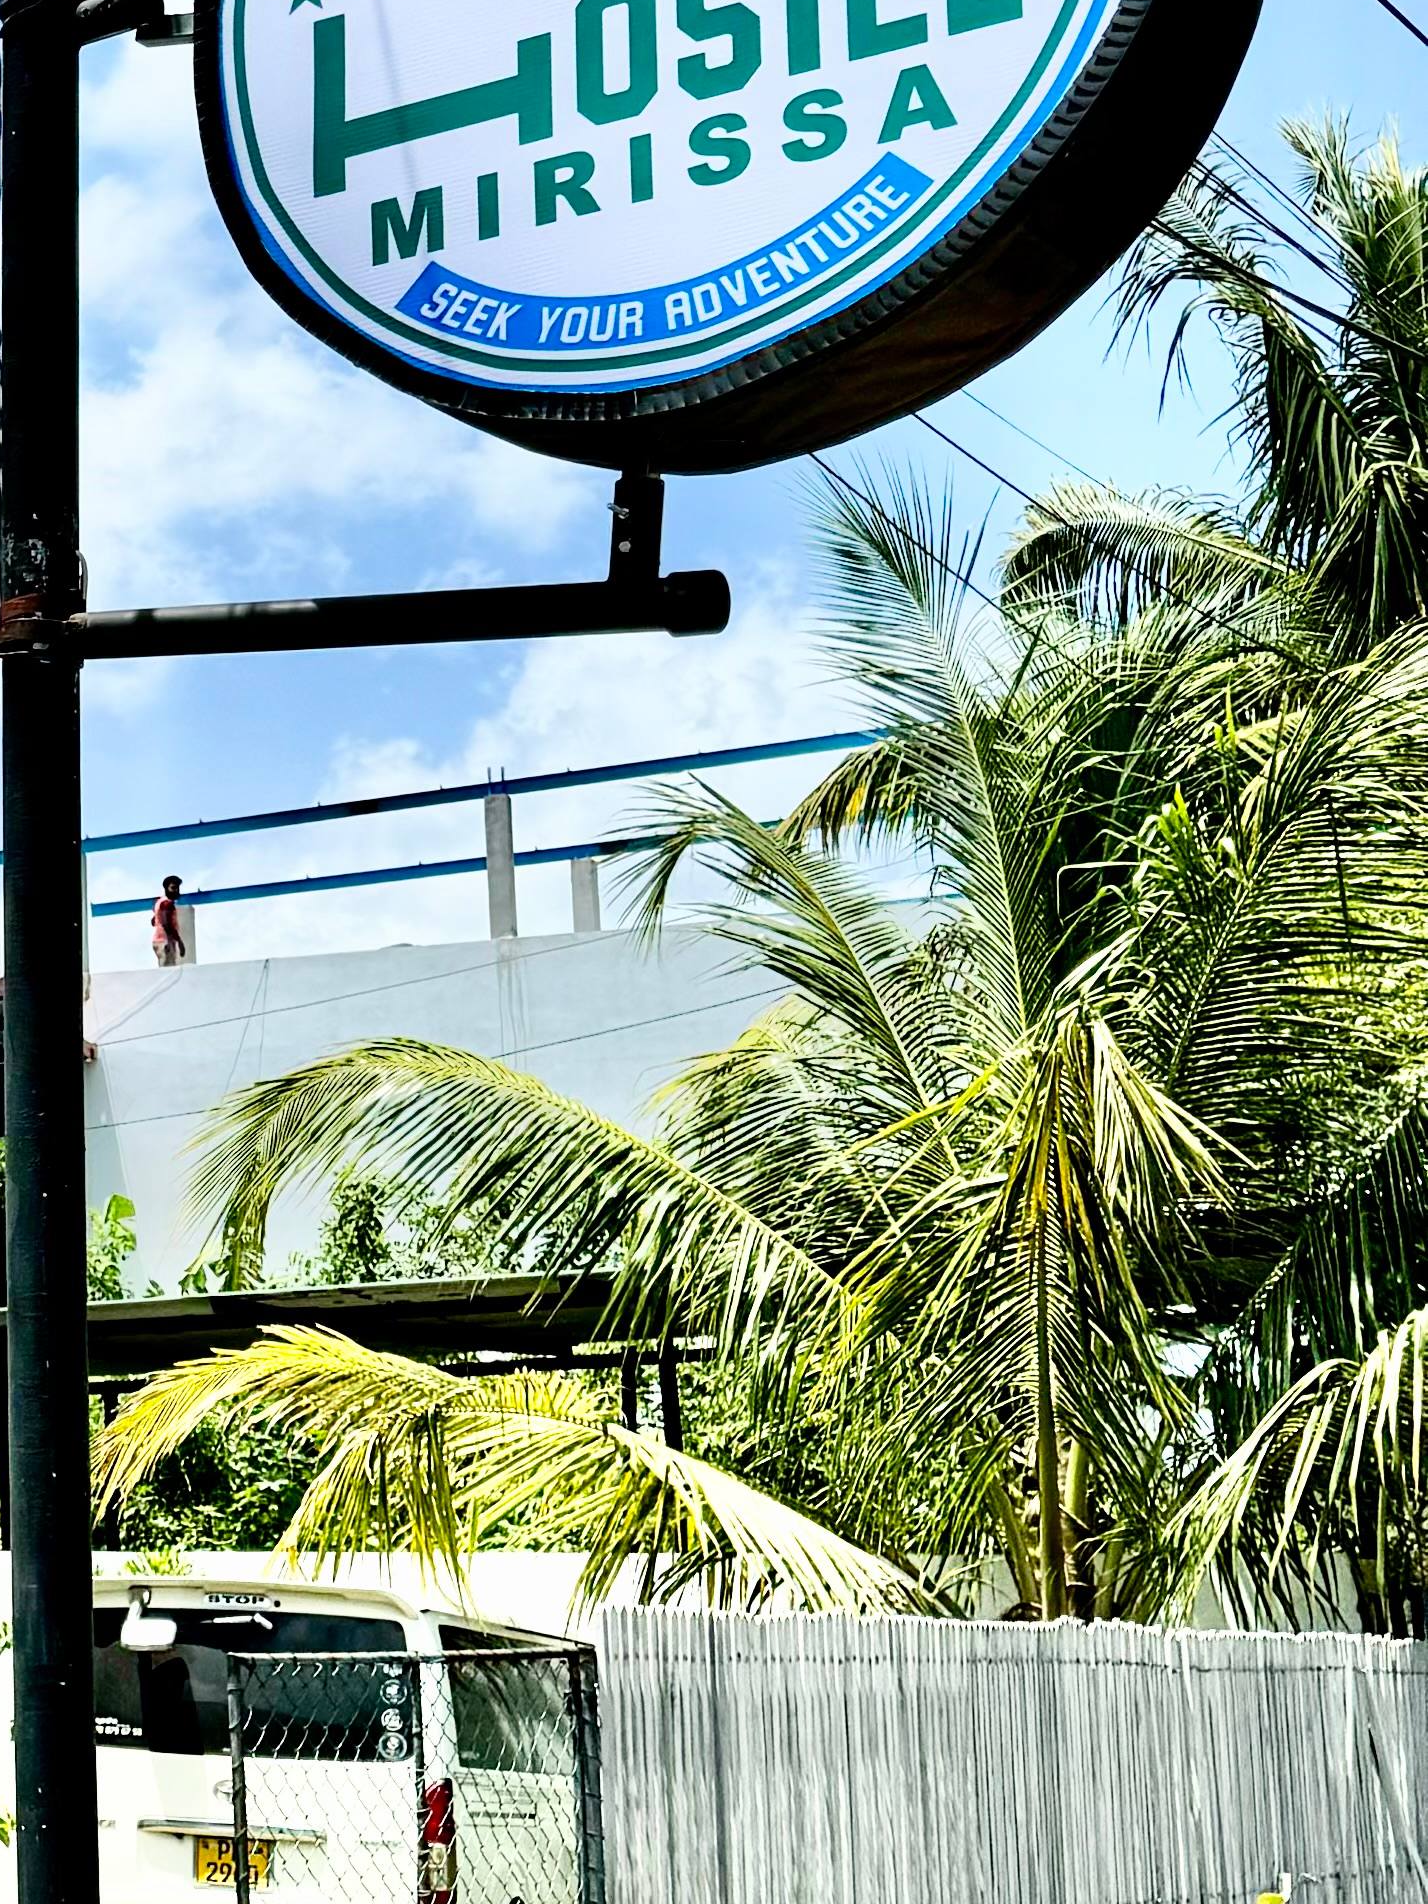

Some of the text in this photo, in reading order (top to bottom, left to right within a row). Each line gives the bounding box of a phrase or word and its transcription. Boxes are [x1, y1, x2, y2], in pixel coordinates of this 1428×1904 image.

[370, 63, 958, 266] MIRISSA
[420, 172, 912, 345] SEEK YOUR ADVENTURE
